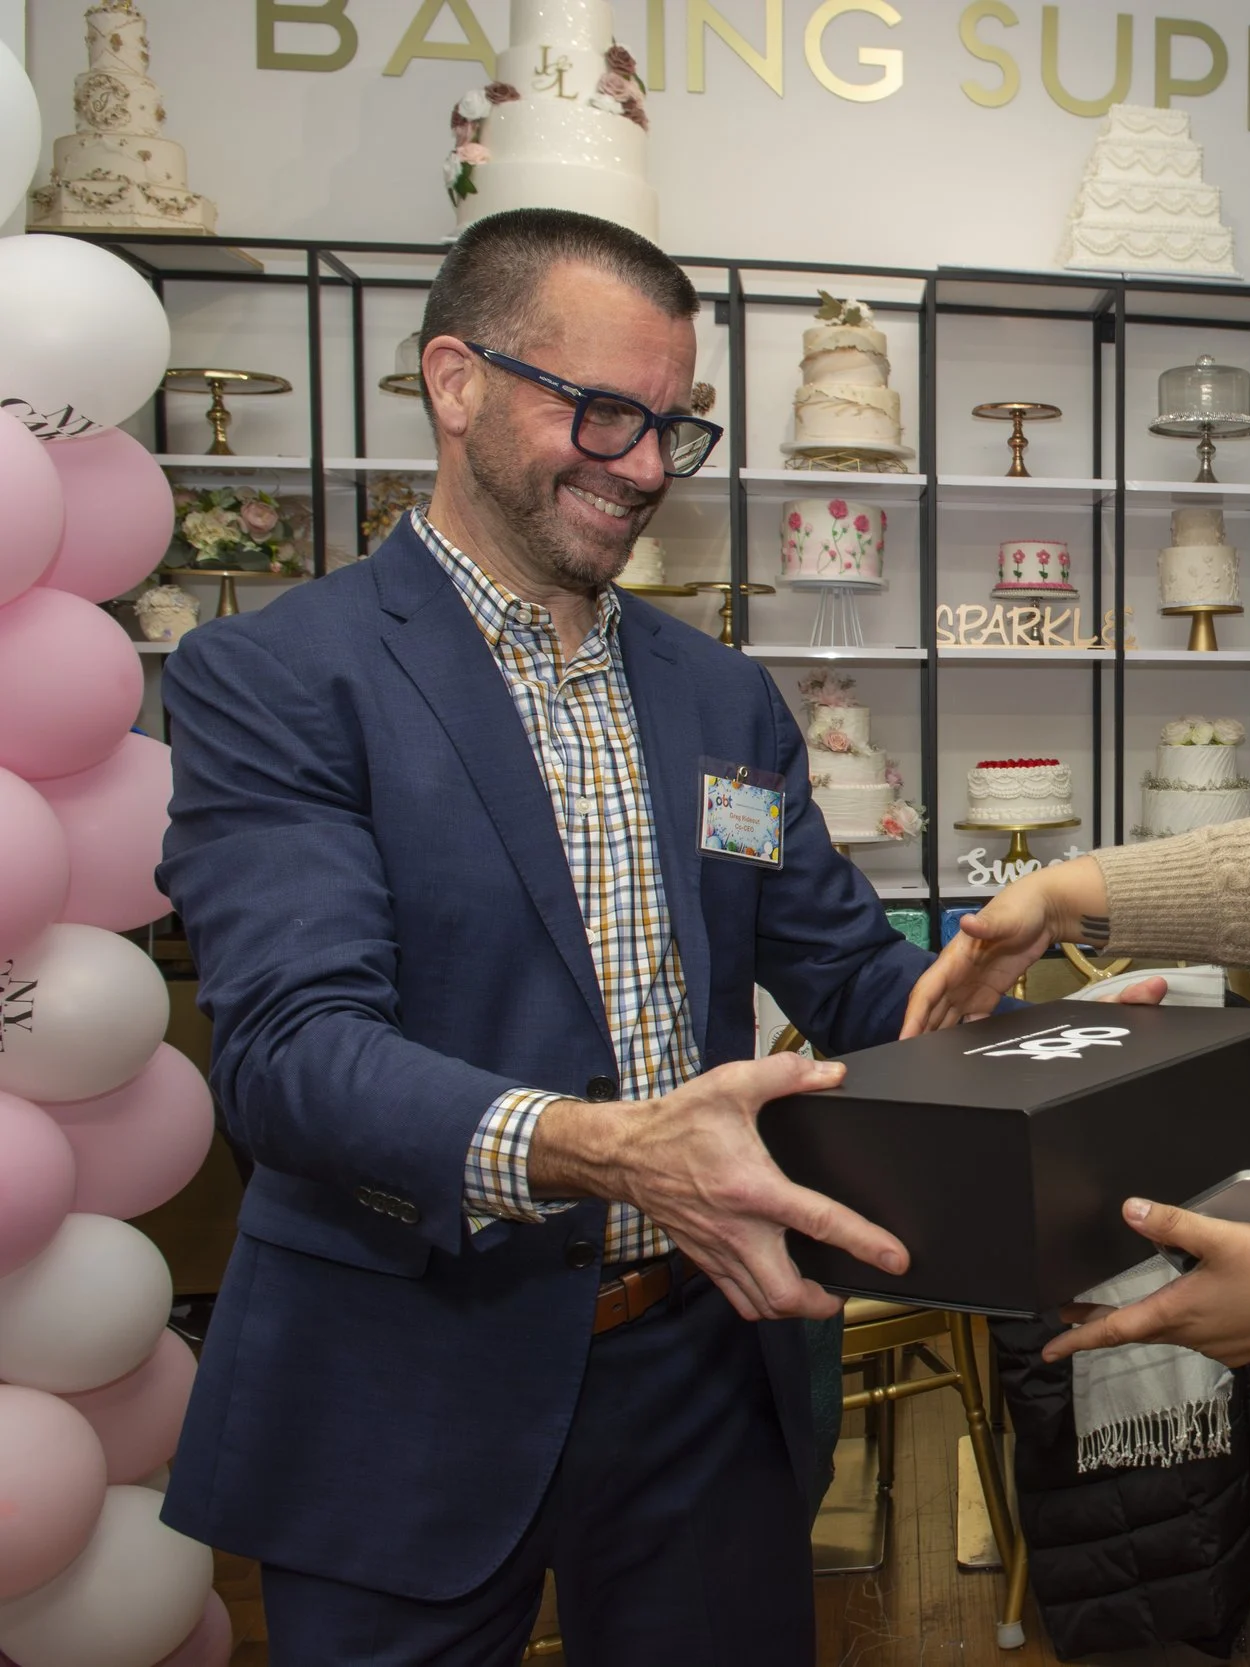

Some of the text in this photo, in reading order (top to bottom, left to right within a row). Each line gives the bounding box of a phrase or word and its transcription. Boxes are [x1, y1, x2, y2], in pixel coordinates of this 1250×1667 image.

[256, 0, 904, 102] BAING
[936, 604, 1139, 646] SPARKLE
[982, 1026, 1132, 1061] obt
